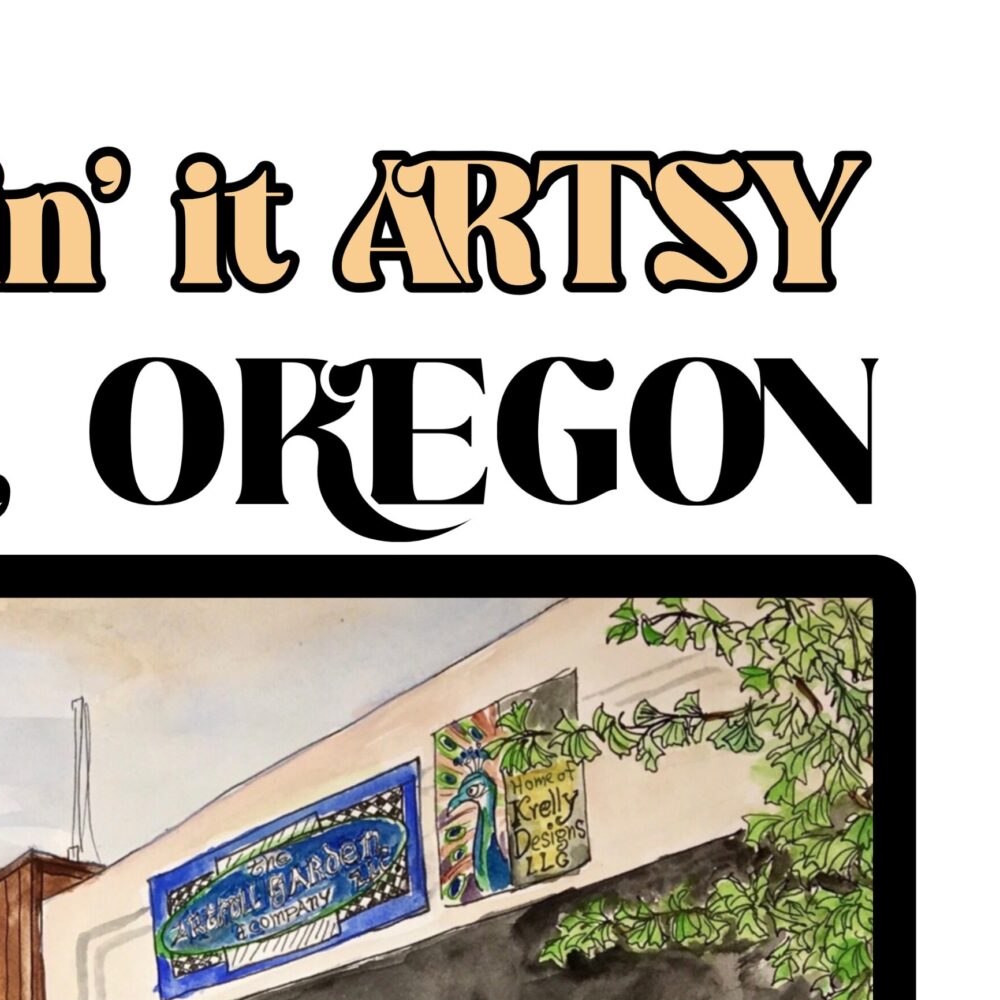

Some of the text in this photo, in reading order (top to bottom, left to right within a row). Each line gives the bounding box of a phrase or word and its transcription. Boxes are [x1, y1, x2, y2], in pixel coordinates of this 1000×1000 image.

[510, 760, 577, 795] Home of
[508, 787, 579, 828] Krelly
[514, 819, 587, 859] Designs
